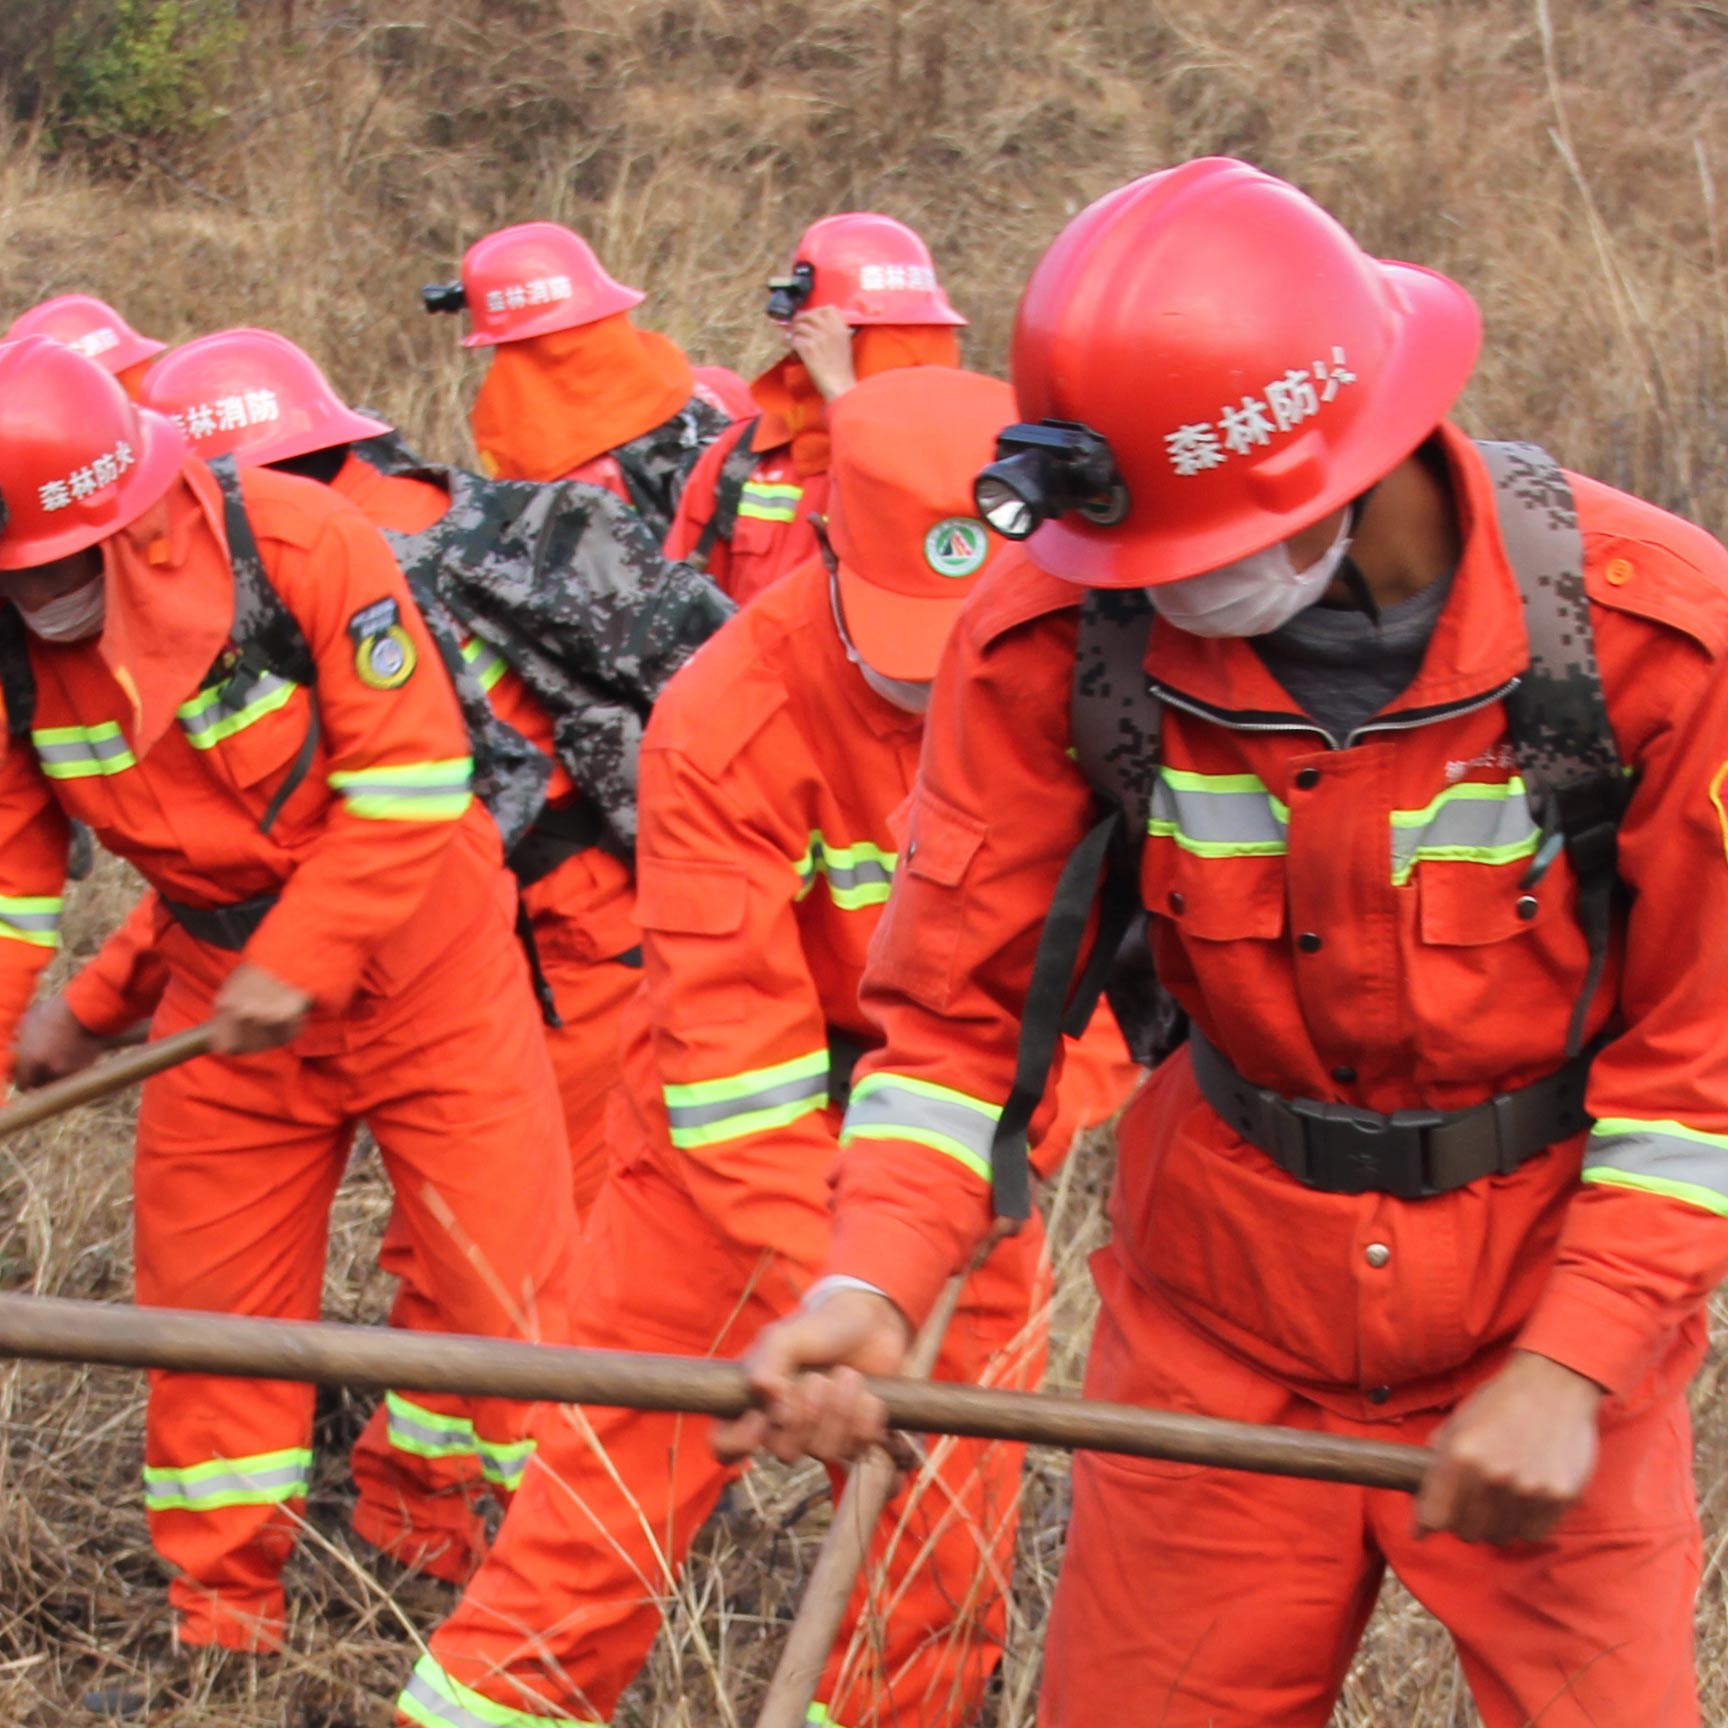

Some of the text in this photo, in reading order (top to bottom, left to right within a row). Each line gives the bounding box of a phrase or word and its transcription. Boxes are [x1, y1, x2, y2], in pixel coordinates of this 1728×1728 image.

[1163, 345, 1357, 476] 森林防火
[37, 440, 135, 512] 森林防火
